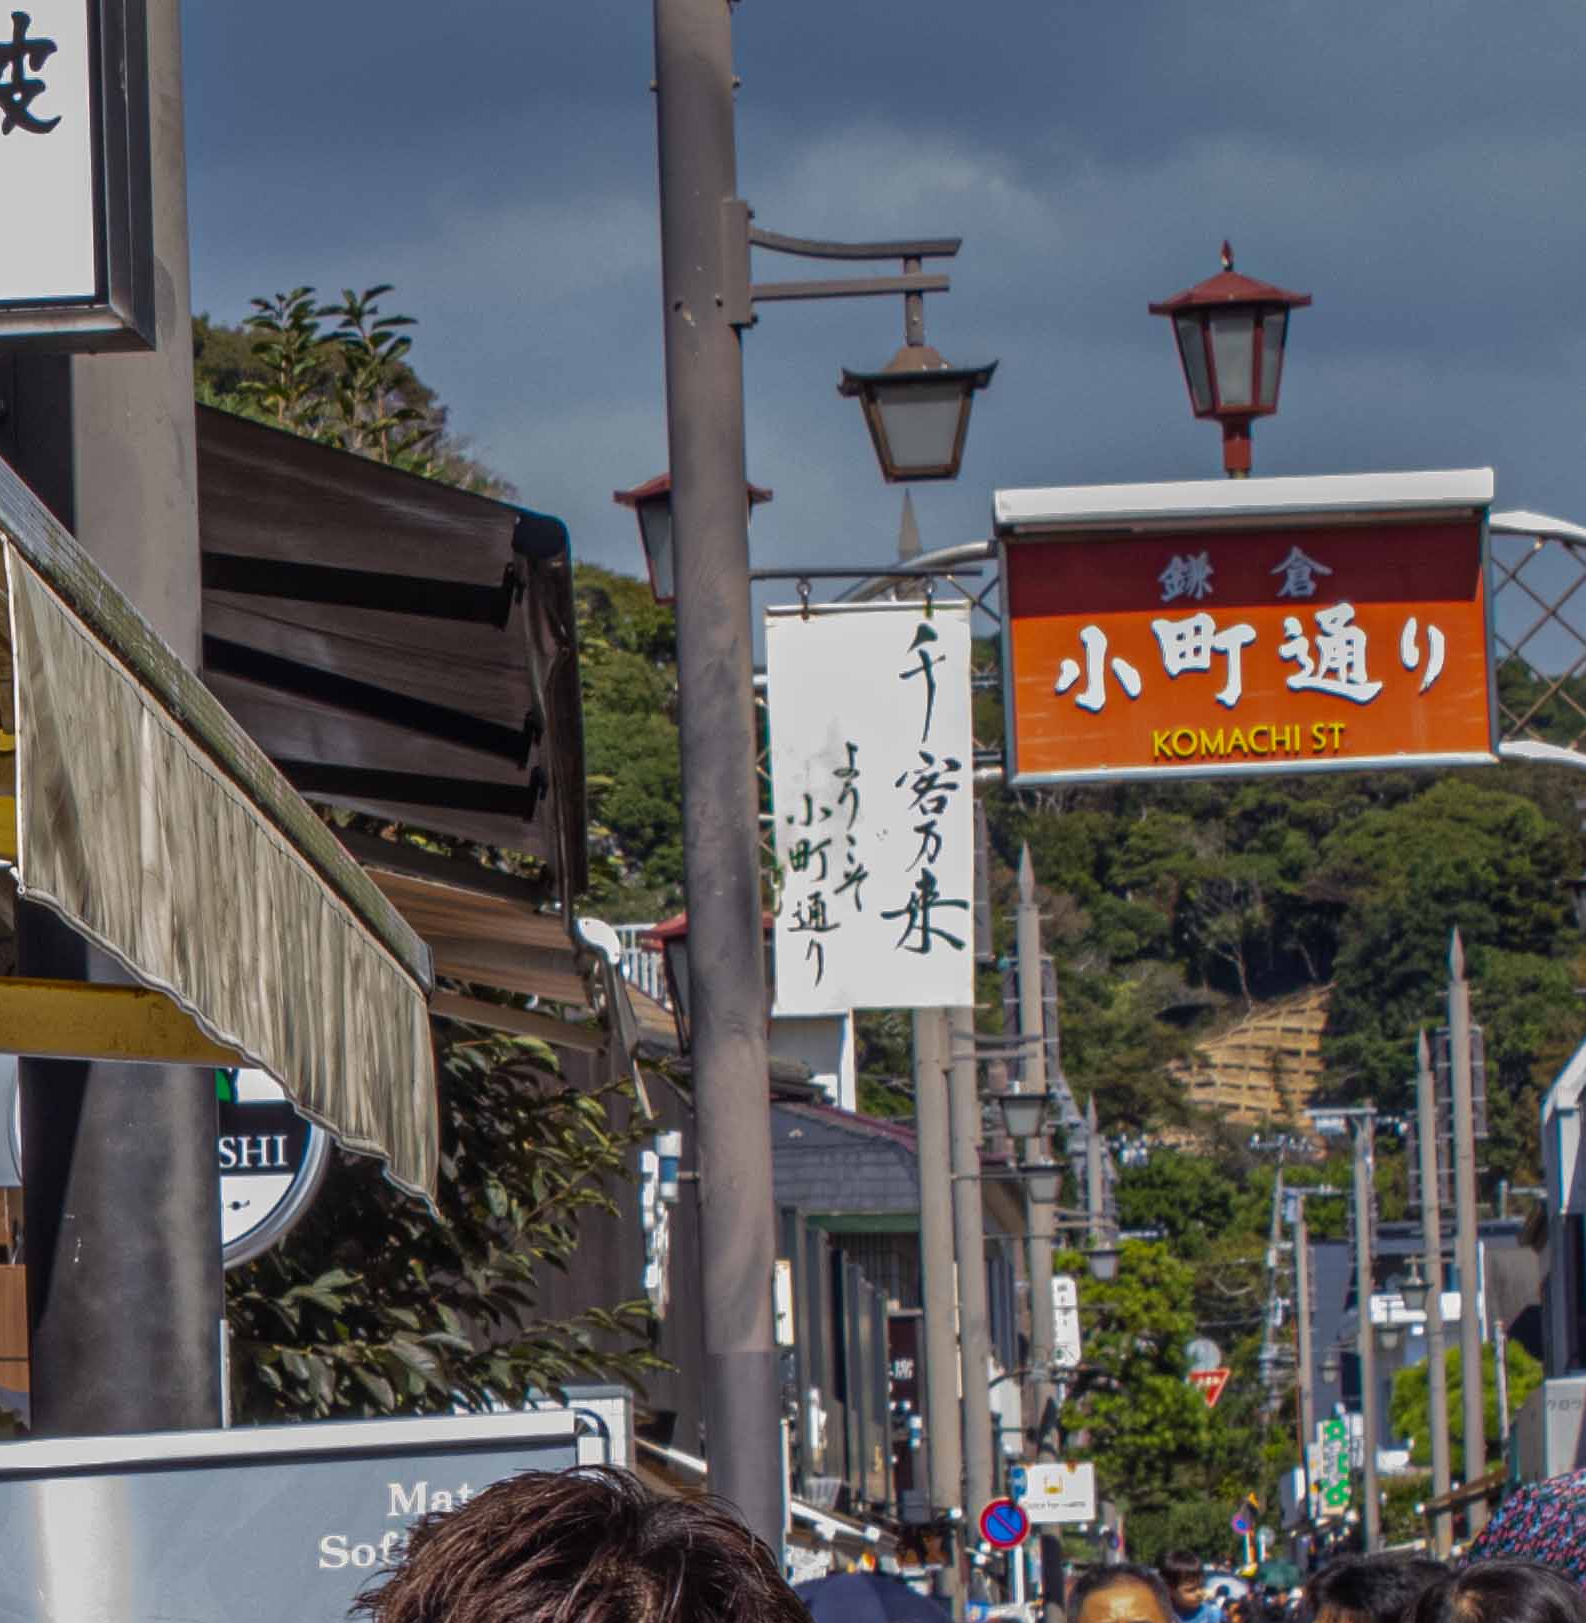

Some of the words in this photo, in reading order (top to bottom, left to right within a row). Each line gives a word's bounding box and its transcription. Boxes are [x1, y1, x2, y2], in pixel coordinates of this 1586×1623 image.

[1160, 545, 1332, 600] 鎌倉
[1055, 602, 1448, 711] 小町通り
[880, 623, 970, 954] 千客万来
[1151, 724, 1301, 760] KOMACHI
[1311, 722, 1347, 753] ST
[787, 793, 841, 987] 小町通り
[833, 740, 868, 912] ようこそ
